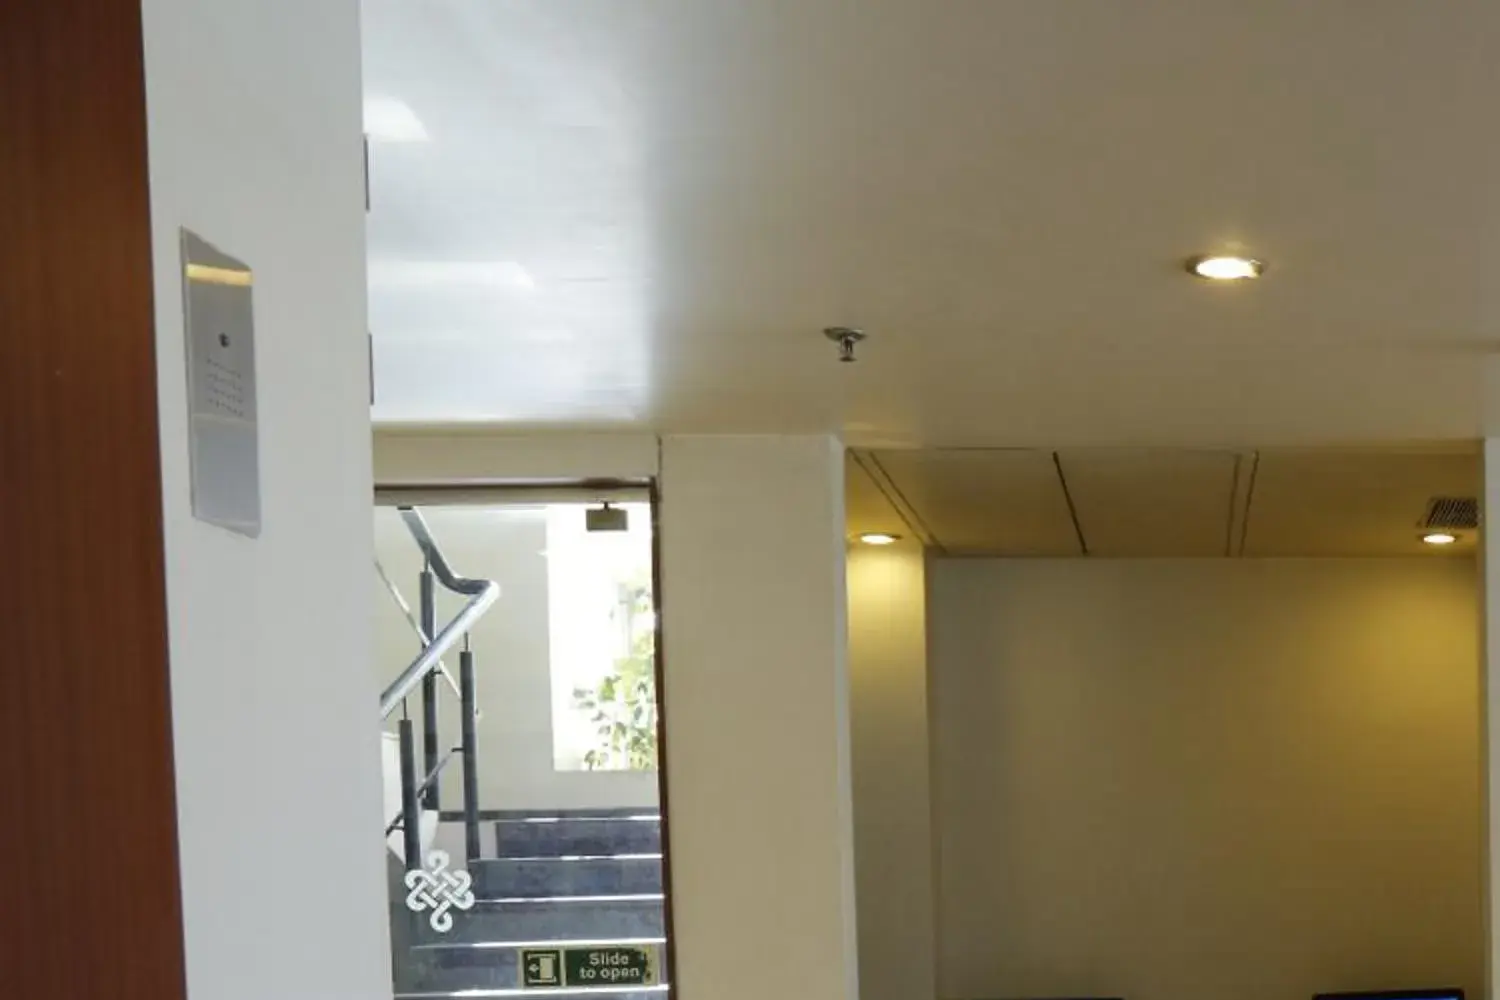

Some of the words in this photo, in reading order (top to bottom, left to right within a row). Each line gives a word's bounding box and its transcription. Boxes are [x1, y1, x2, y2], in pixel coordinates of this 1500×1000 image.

[589, 951, 629, 966] Slide
[579, 967, 597, 979] to
[600, 966, 640, 981] open
